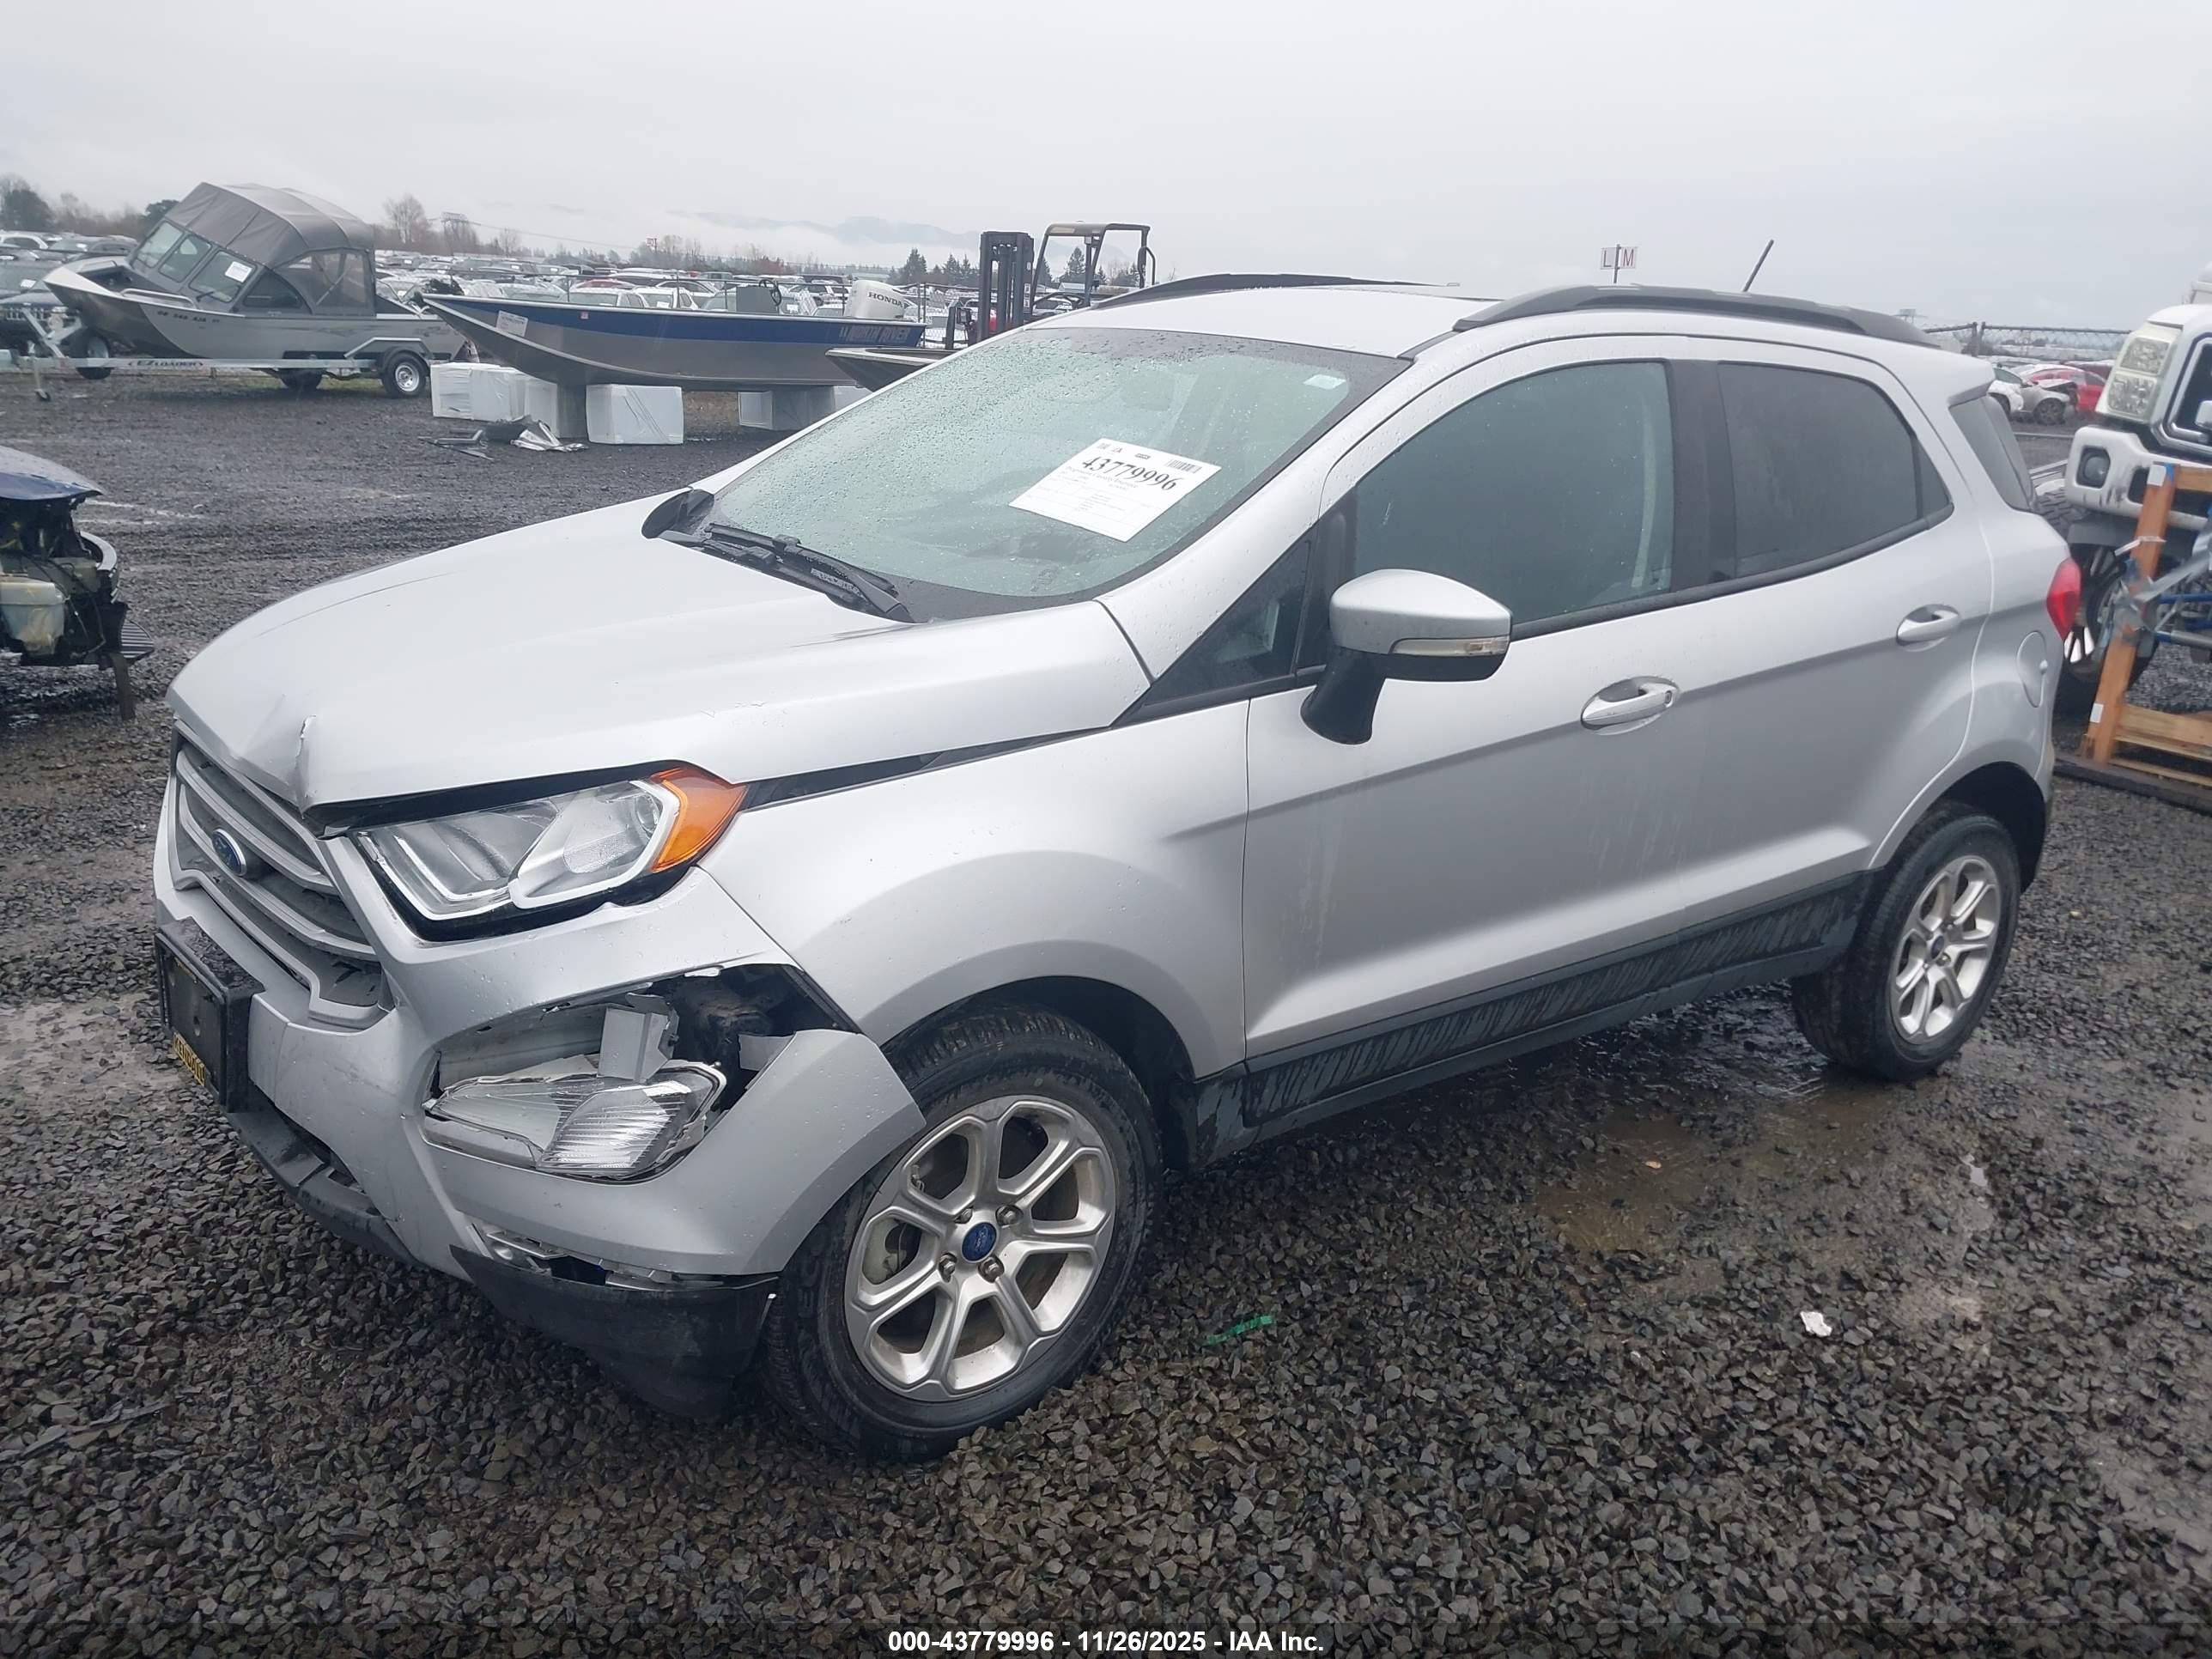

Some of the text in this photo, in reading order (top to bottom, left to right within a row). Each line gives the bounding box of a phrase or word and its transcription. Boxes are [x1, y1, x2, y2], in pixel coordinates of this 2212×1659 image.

[1603, 250, 1612, 267] L
[1623, 248, 1634, 266] M
[868, 292, 903, 307] HONDA
[1082, 456, 1184, 491] 43779996
